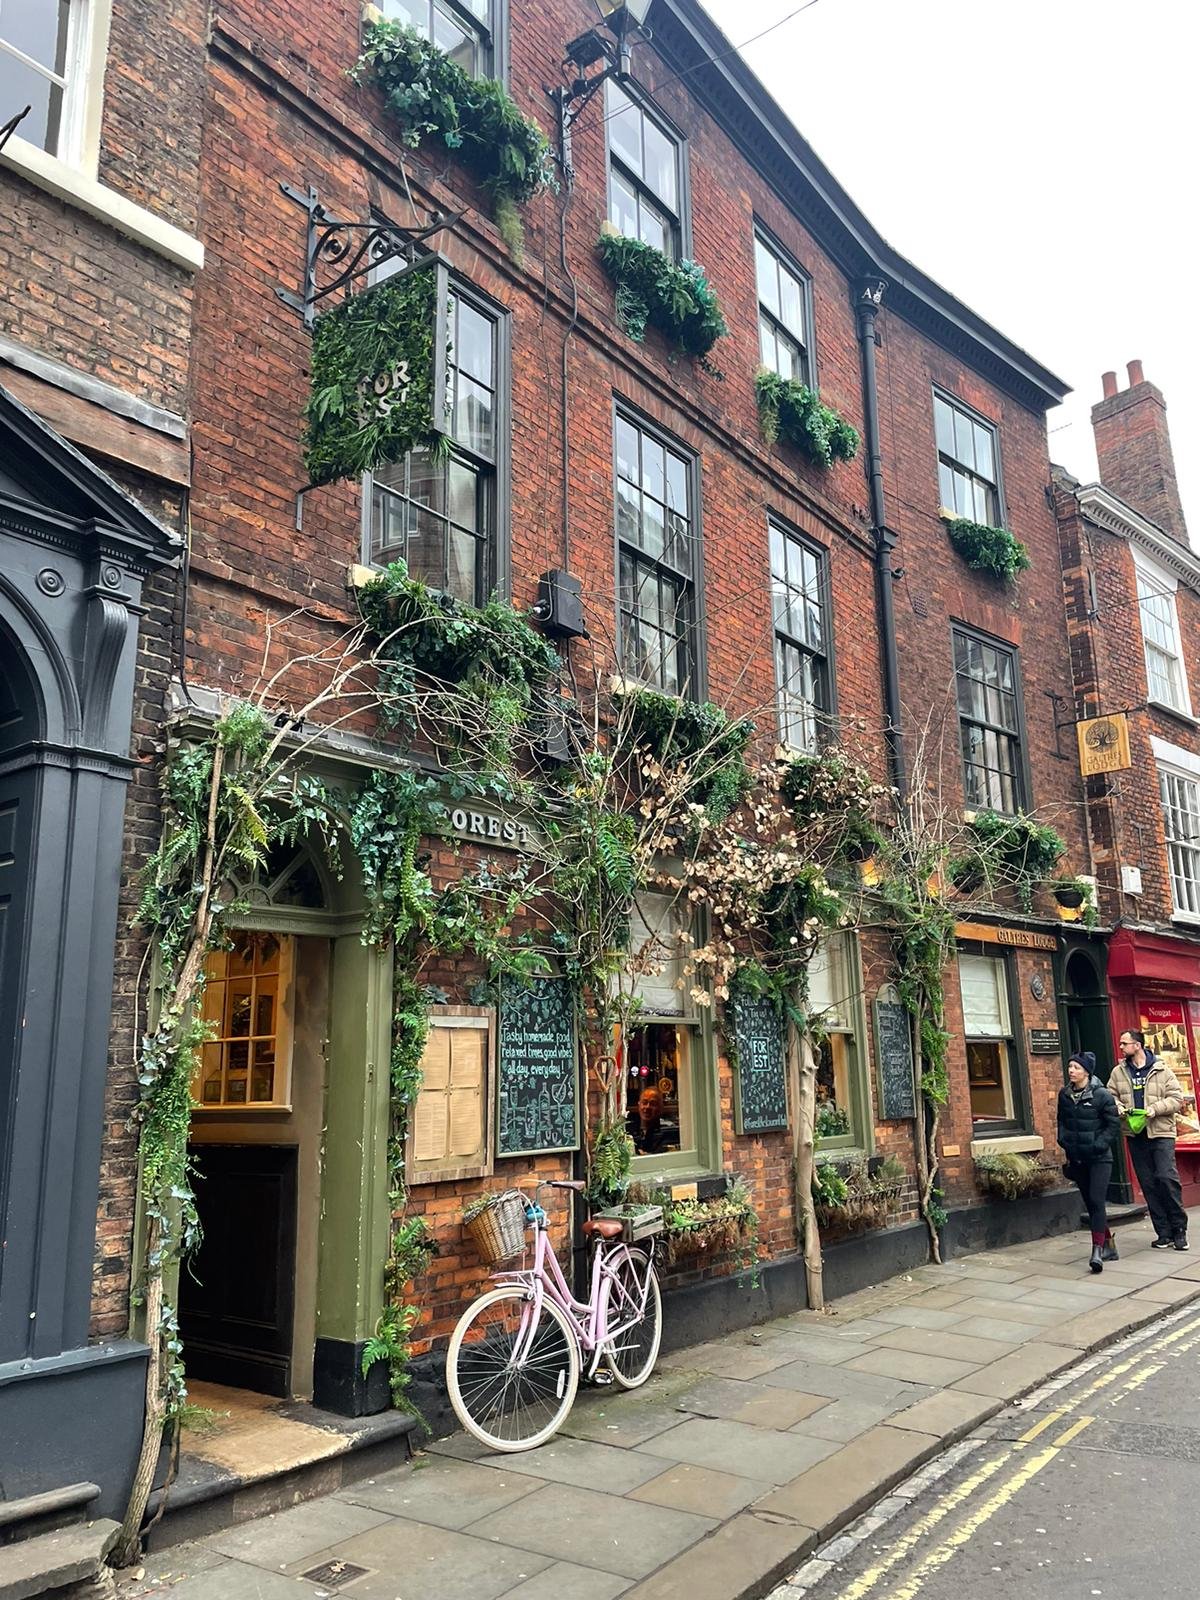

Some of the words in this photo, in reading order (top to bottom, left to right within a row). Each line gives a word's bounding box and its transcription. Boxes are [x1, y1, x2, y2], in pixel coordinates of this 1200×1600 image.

[1148, 1007, 1172, 1018] Nougat
[501, 1027, 523, 1046] Tasty
[523, 1027, 554, 1043] homemade
[502, 1044, 527, 1058] relaxed
[543, 1045, 557, 1061] good
[557, 1044, 573, 1058] vibes
[753, 1040, 767, 1054] FOR
[754, 1054, 768, 1068] EST
